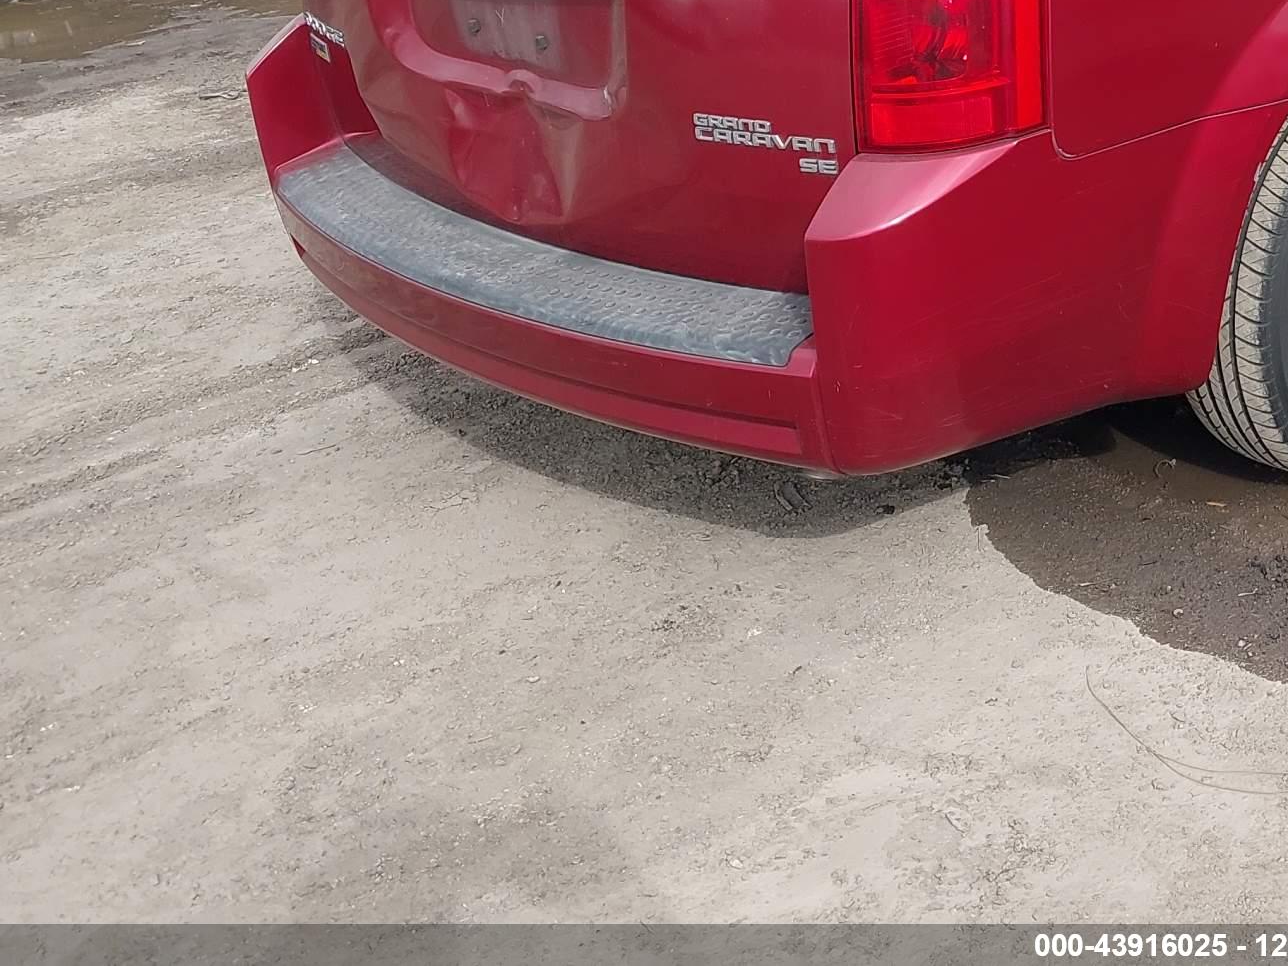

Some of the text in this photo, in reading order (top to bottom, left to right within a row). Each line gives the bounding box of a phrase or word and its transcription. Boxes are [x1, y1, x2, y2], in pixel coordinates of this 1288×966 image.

[693, 113, 770, 133] GRAND
[695, 127, 836, 153] CARAVAN
[799, 159, 838, 175] SE
